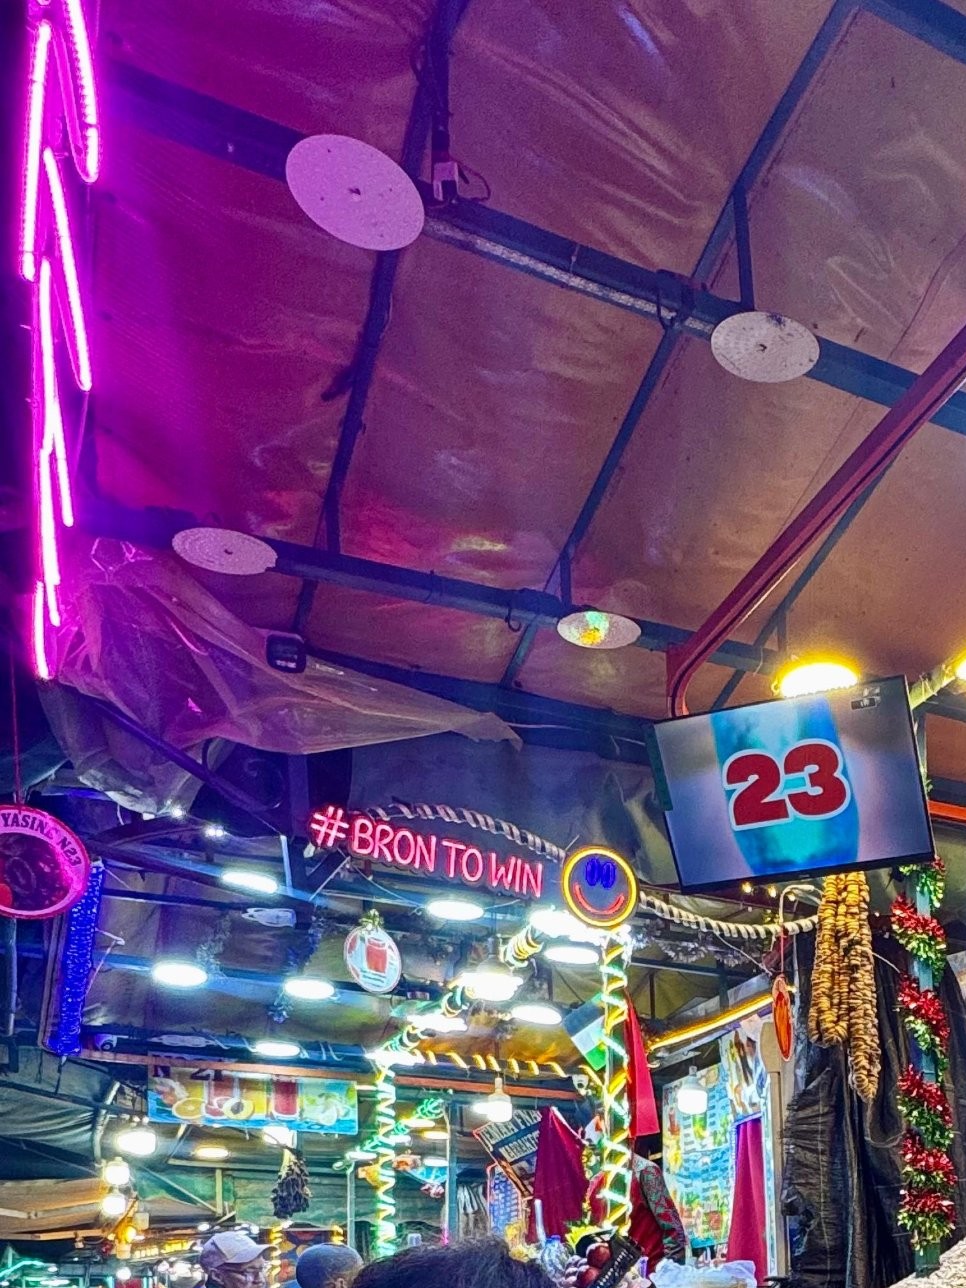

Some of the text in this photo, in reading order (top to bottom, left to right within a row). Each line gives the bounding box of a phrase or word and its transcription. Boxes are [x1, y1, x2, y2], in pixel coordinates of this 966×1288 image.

[724, 740, 849, 829] 23
[441, 838, 484, 882] TO
[490, 852, 544, 899] WIN
